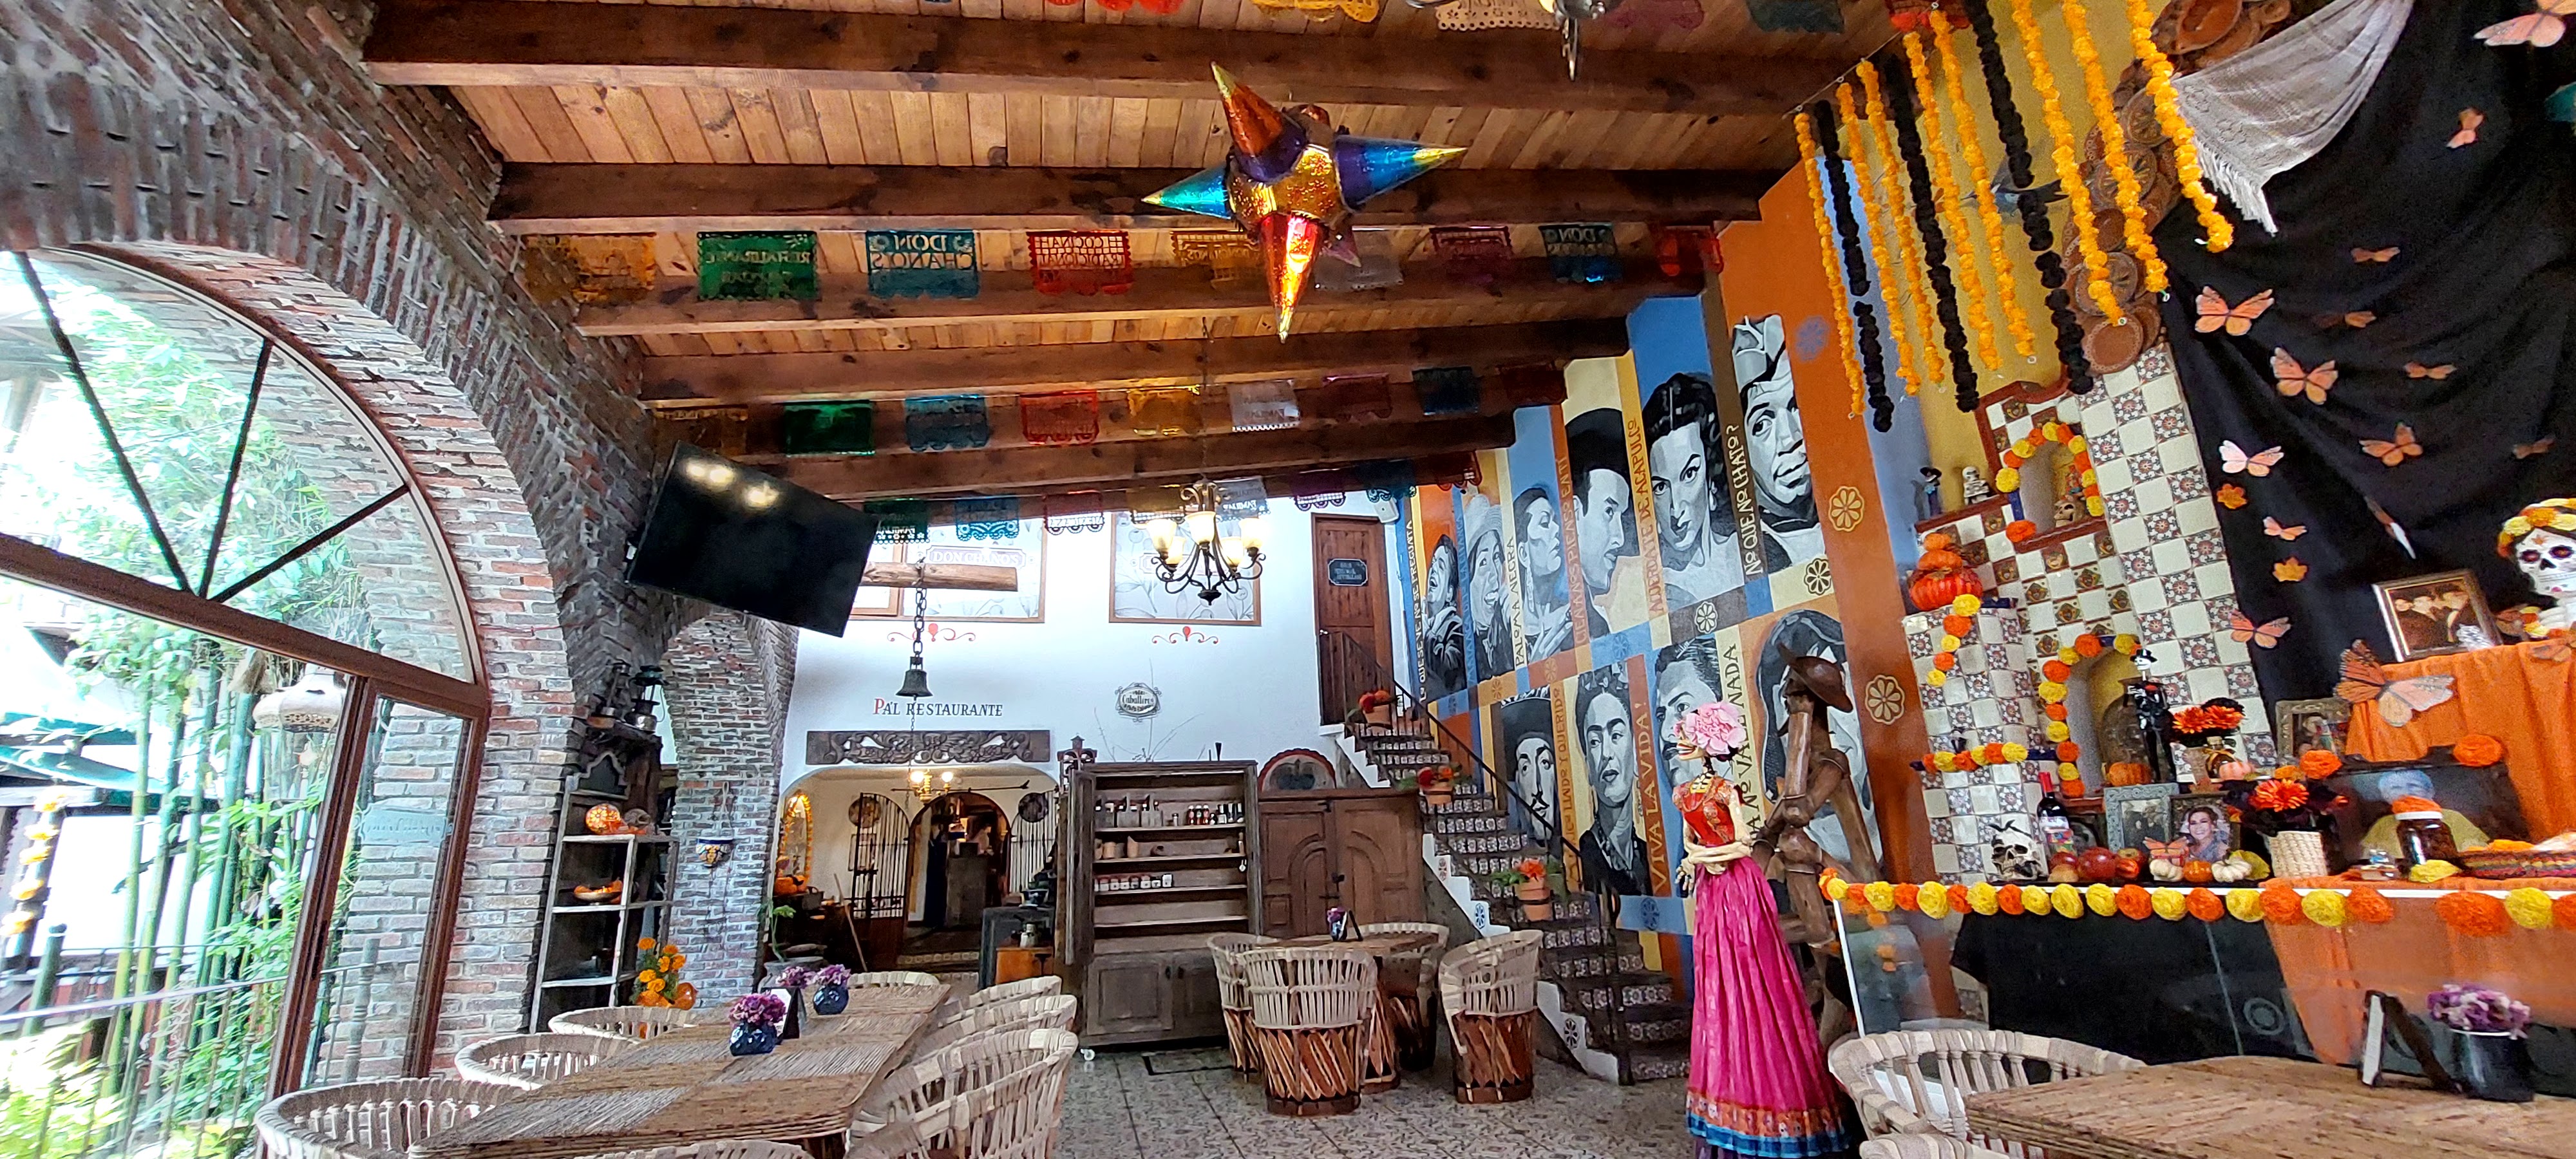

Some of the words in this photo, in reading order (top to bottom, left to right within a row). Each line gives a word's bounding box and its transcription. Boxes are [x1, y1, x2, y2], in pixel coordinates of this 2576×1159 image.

[1628, 419, 1648, 494] ACAPULCO
[1727, 424, 1748, 488] CHATO?
[1564, 501, 1578, 563] PIENSO
[1639, 496, 1651, 522] DE
[1741, 513, 1757, 549] QUE
[933, 551, 963, 563] DON
[1406, 520, 1419, 583] PREGUNTA
[1508, 536, 1519, 594] NEGRA
[1413, 584, 1419, 601] SE
[1415, 622, 1422, 640] VE
[1418, 641, 1423, 656] SE
[1512, 600, 1524, 666] PALOMA
[1724, 643, 1743, 708] NADA
[906, 702, 1003, 717] RESTAURANTE
[1553, 688, 1566, 752] QUERIDO
[1645, 780, 1659, 816] LA
[1653, 821, 1667, 890] VIVA
